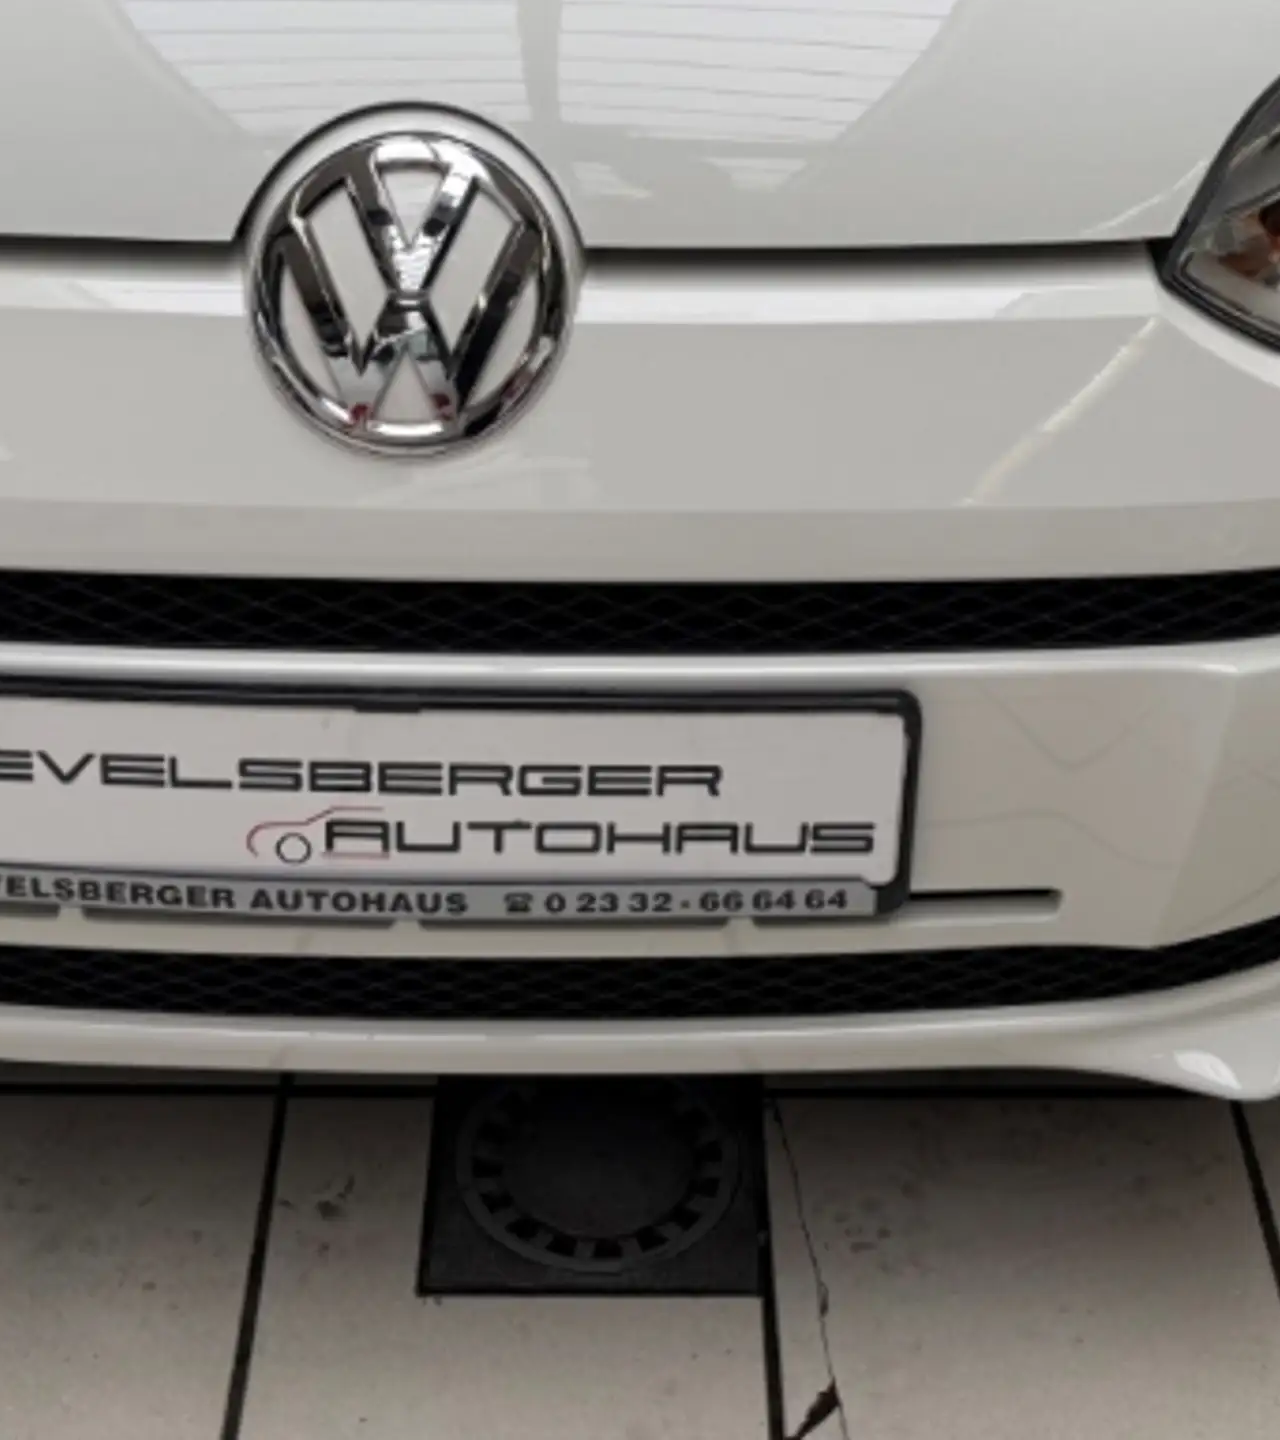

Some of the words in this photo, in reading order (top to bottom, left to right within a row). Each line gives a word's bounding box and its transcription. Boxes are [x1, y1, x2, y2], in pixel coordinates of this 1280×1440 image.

[324, 818, 876, 855] AUTOHAUS
[249, 888, 468, 915] AUTOHAUS
[544, 892, 566, 912] 0
